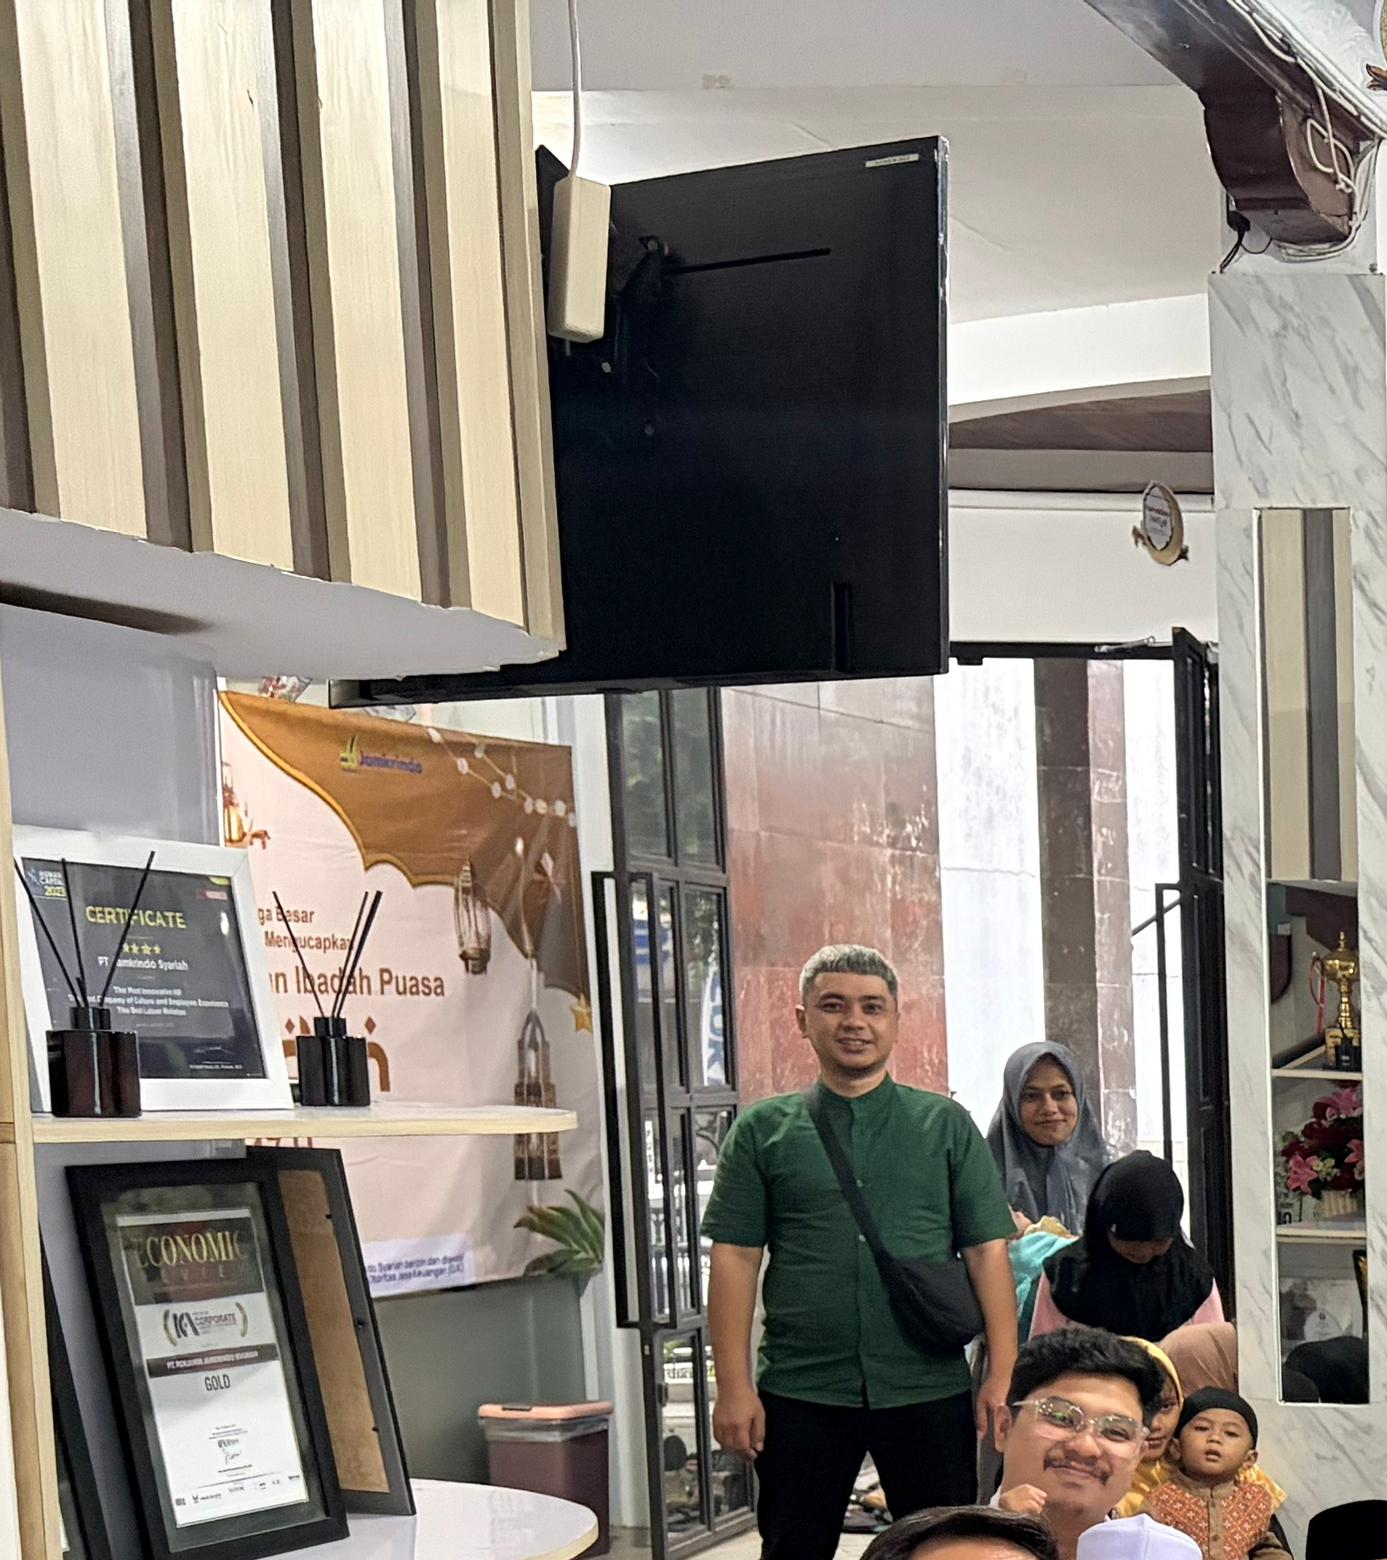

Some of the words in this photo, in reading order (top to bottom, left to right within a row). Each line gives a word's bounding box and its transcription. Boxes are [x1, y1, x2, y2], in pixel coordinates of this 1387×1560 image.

[85, 905, 187, 929] CERTIFICATE
[276, 906, 315, 924] Besar
[116, 957, 157, 970] amkrindo
[296, 966, 372, 997] Ibadah
[380, 968, 445, 996] Puasa
[205, 1374, 231, 1391] GOLD
